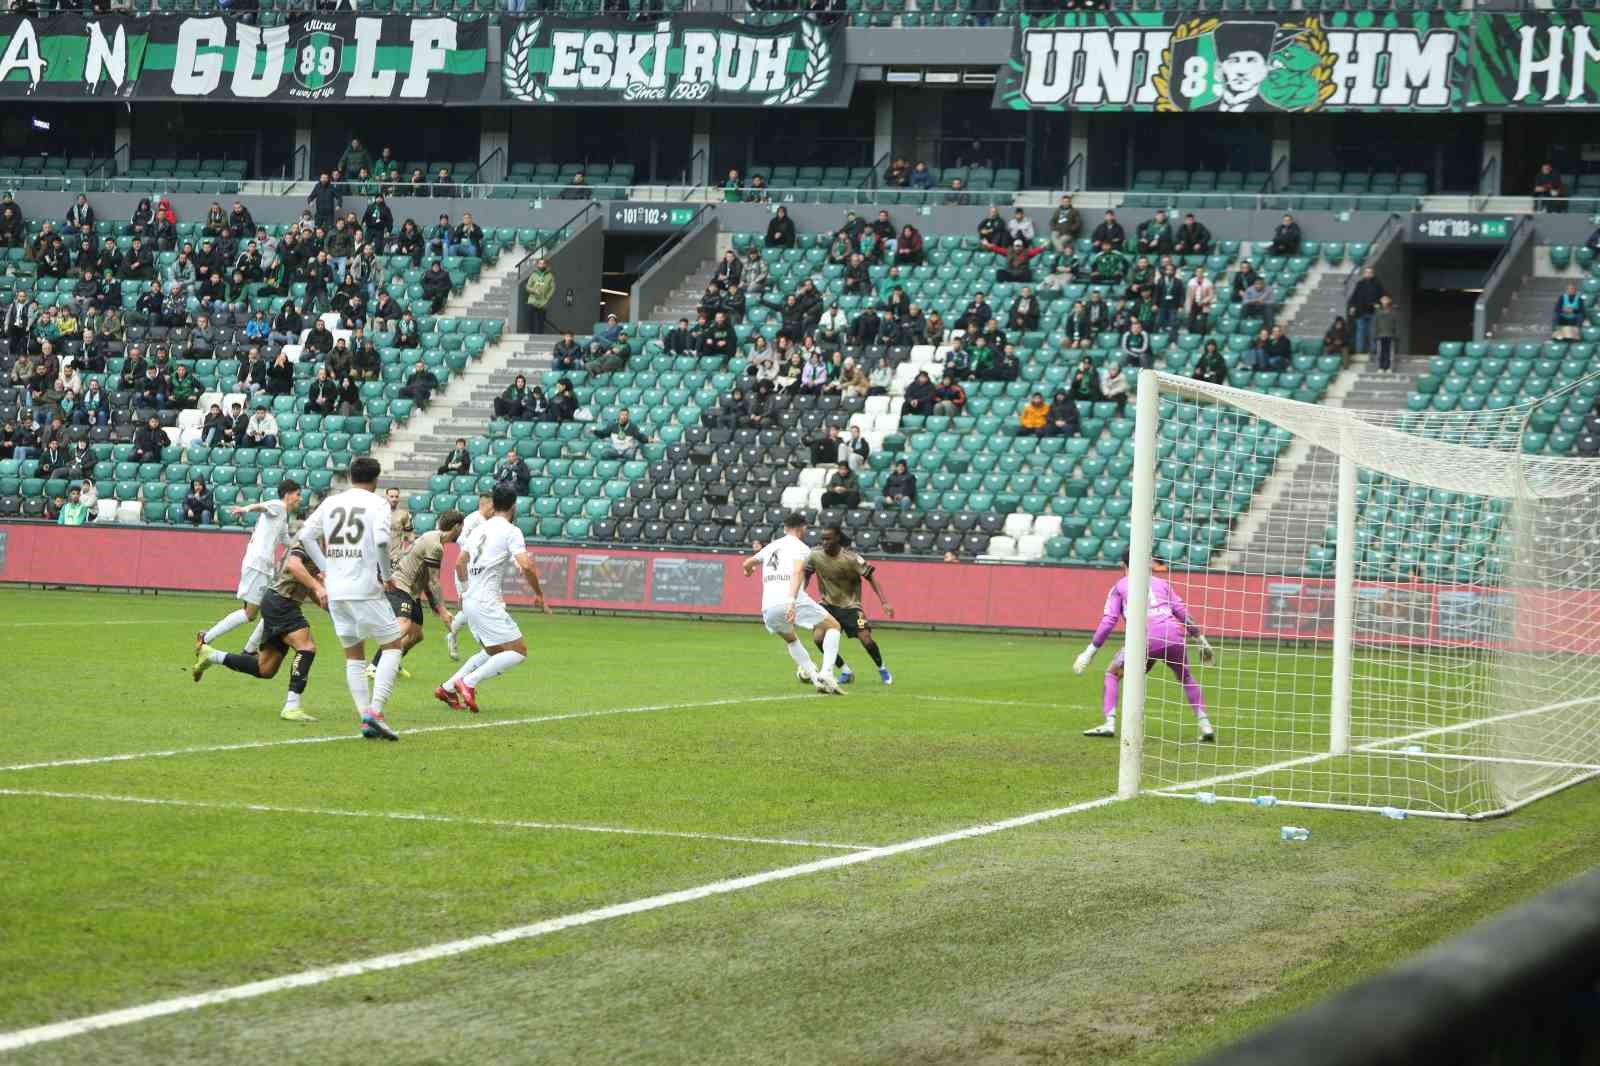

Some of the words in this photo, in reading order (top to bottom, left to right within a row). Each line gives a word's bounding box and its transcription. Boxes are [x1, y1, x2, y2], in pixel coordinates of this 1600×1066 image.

[304, 19, 337, 31] Ultras
[300, 45, 335, 76] 89
[547, 20, 671, 89] ESKİ
[680, 31, 793, 91] RUH
[1024, 31, 1174, 103] UNI
[1324, 32, 1457, 105] HM
[623, 82, 666, 100] Since
[670, 82, 710, 100] 1989
[623, 208, 637, 224] 101
[644, 208, 660, 224] 102
[328, 506, 366, 545] 25
[766, 551, 780, 571] 4
